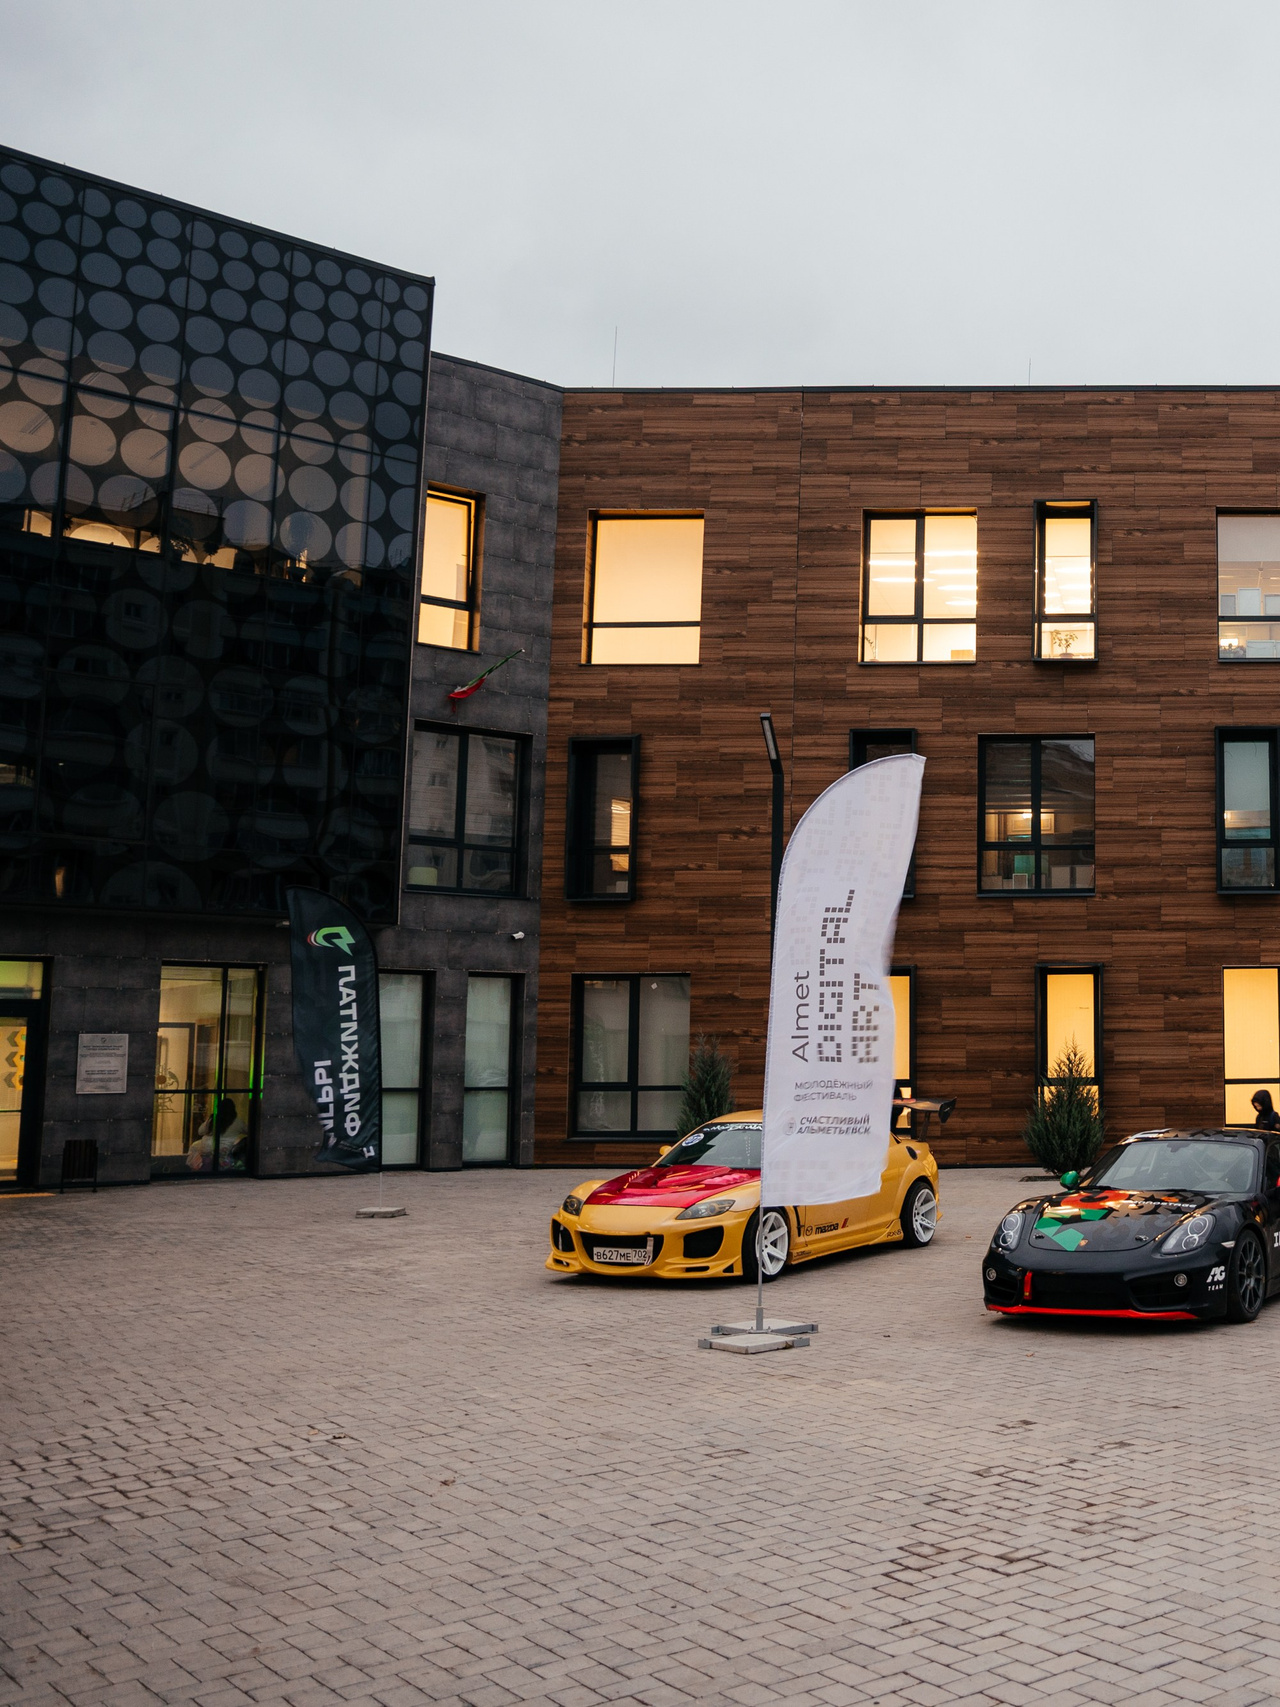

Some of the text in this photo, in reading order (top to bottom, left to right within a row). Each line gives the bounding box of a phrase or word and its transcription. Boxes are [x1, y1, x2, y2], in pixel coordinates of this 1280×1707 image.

[791, 970, 810, 1063] Almet
[816, 889, 855, 1063] DIGITAL
[851, 972, 880, 1064] ART
[793, 1091, 858, 1102] ФЕСТИВАЛЬ
[800, 1113, 871, 1126] СЧАСТЛИВЫЙ
